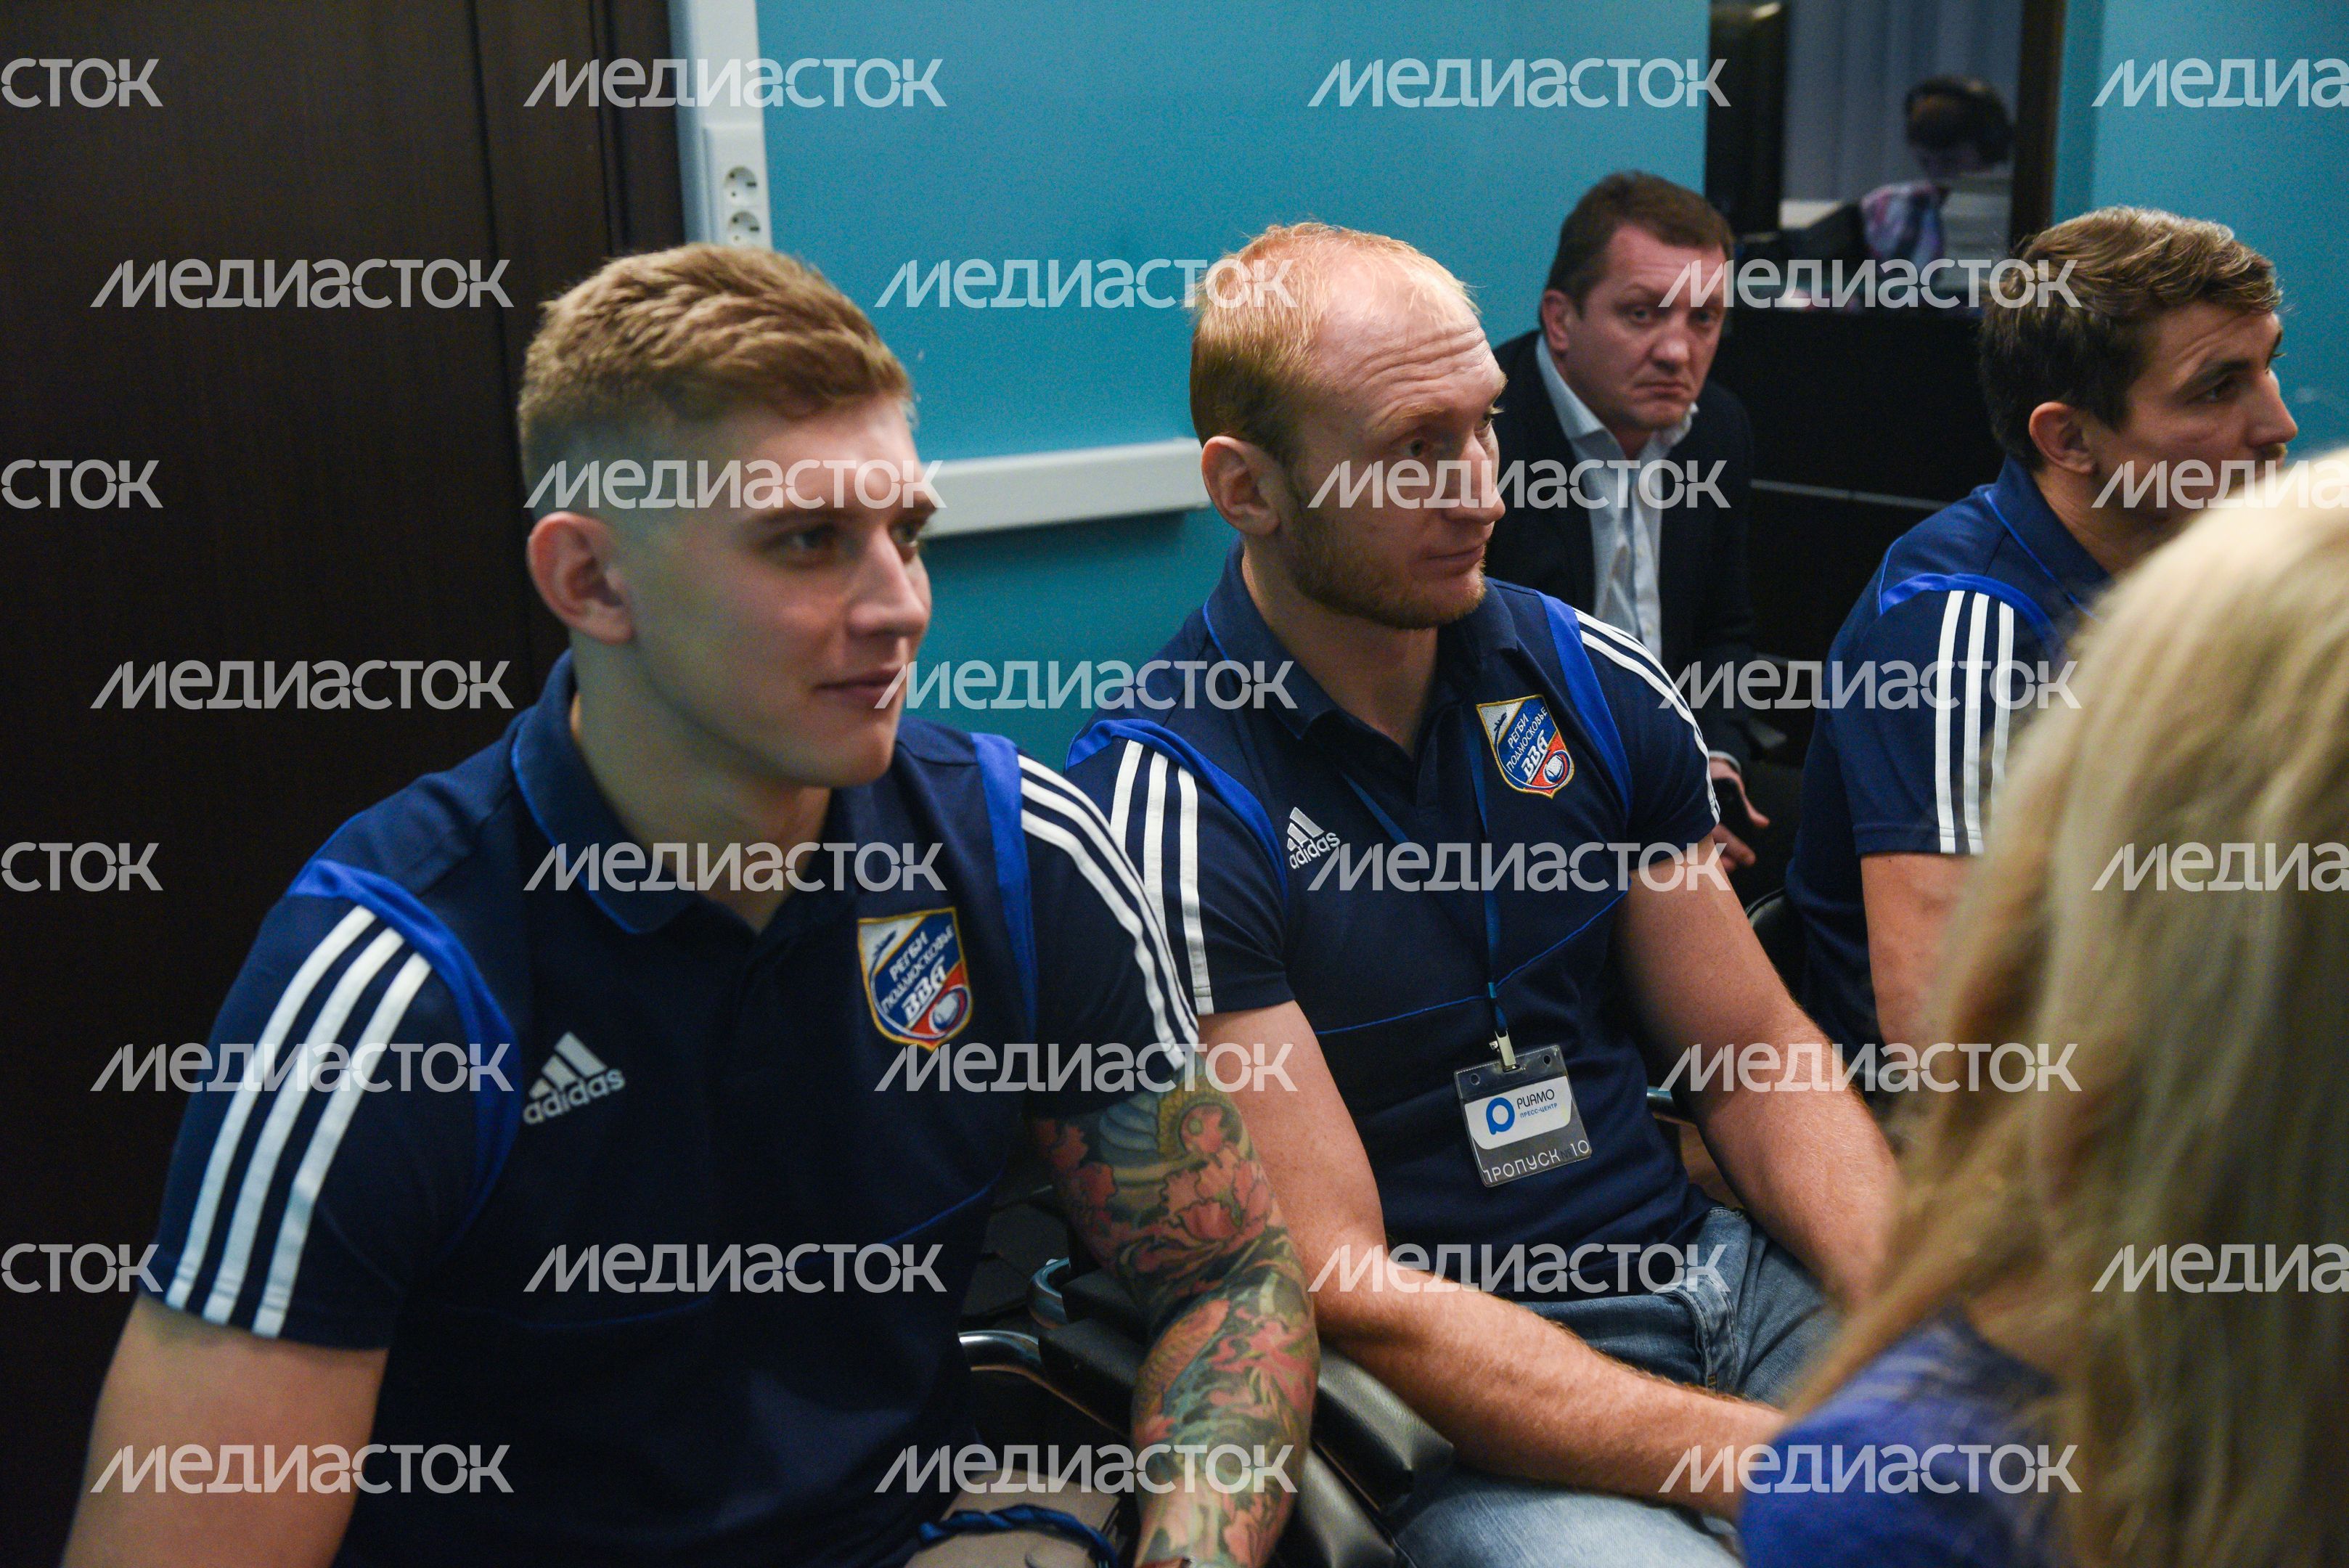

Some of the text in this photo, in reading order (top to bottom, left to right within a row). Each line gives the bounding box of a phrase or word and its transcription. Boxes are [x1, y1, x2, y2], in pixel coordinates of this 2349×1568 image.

[1506, 706, 1548, 772] ПОДМОСКОВЬЕ
[1508, 713, 1529, 748] РЕГБИ
[1289, 833, 1341, 870] adidas
[523, 1069, 626, 1124] adidas
[1517, 1089, 1555, 1110] РИАМО
[1520, 1103, 1558, 1119] ПРЕСС-ЦЕНТР
